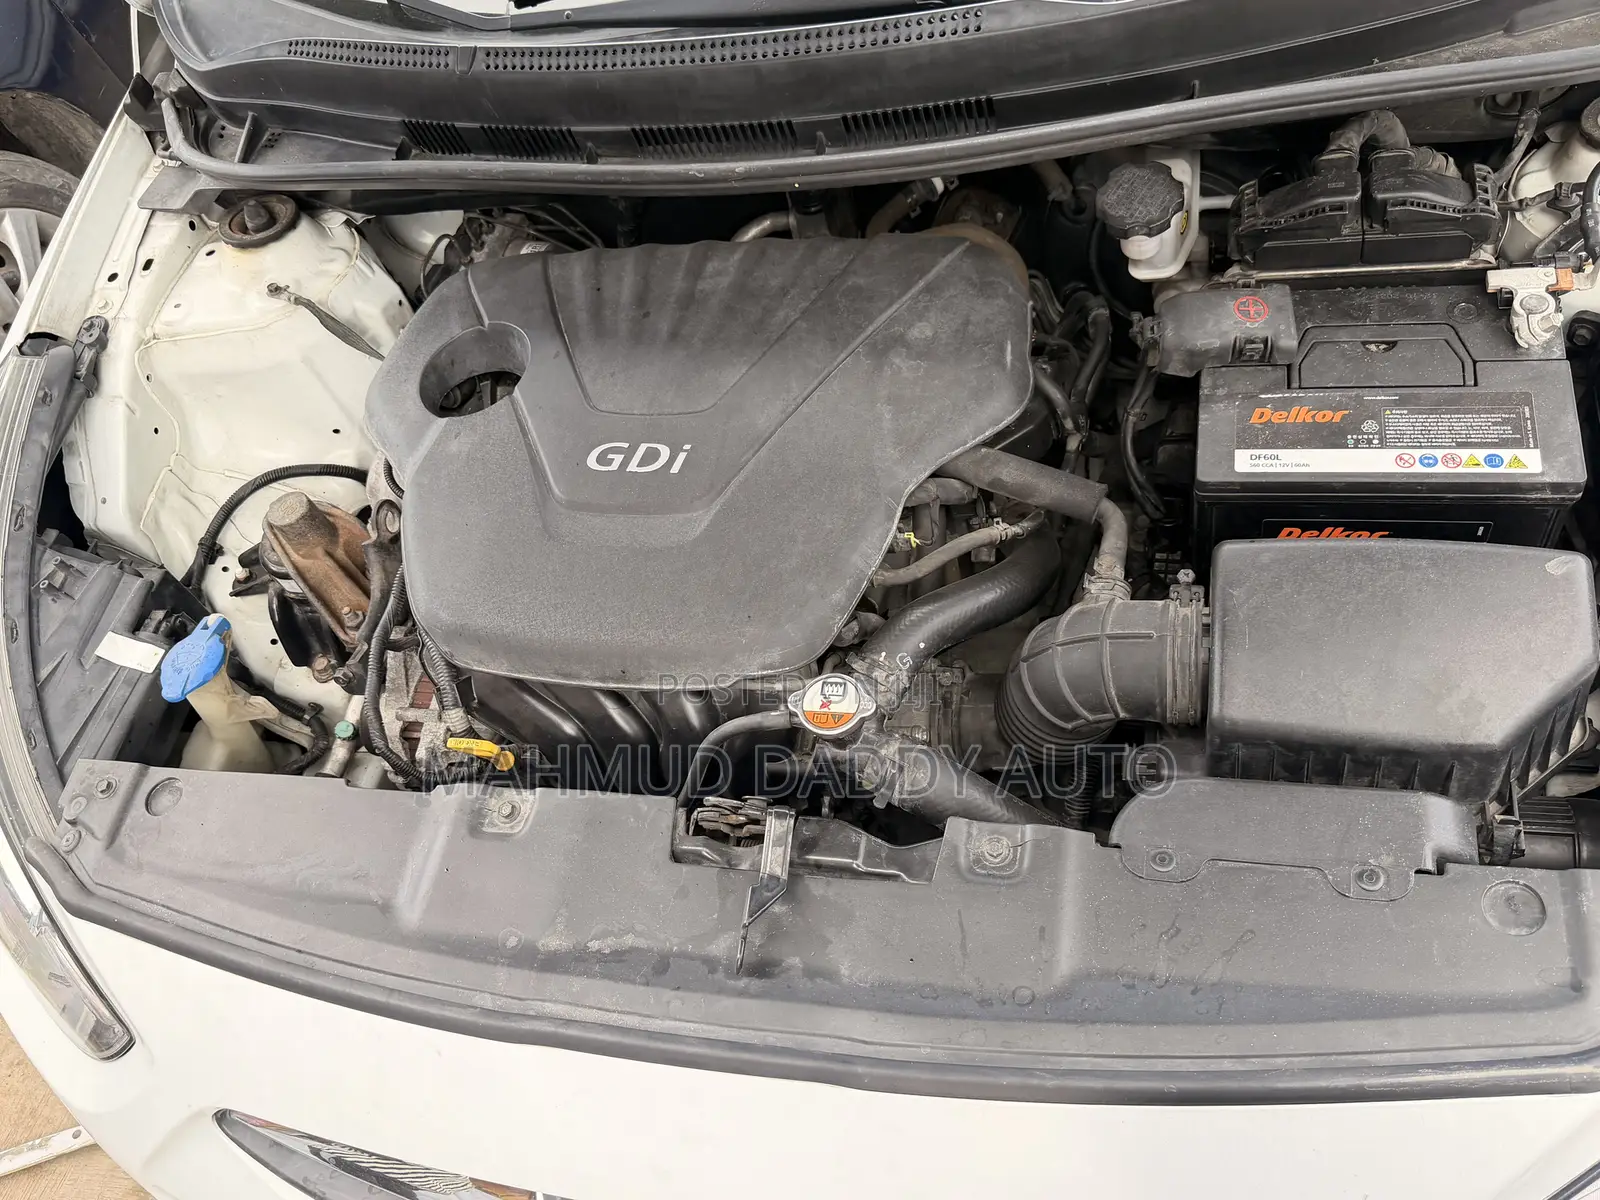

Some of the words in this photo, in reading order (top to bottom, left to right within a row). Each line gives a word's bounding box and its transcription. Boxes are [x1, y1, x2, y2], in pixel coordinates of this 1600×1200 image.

[1249, 406, 1349, 424] Delkor
[586, 442, 692, 474] GDi
[1249, 453, 1282, 461] DF60L
